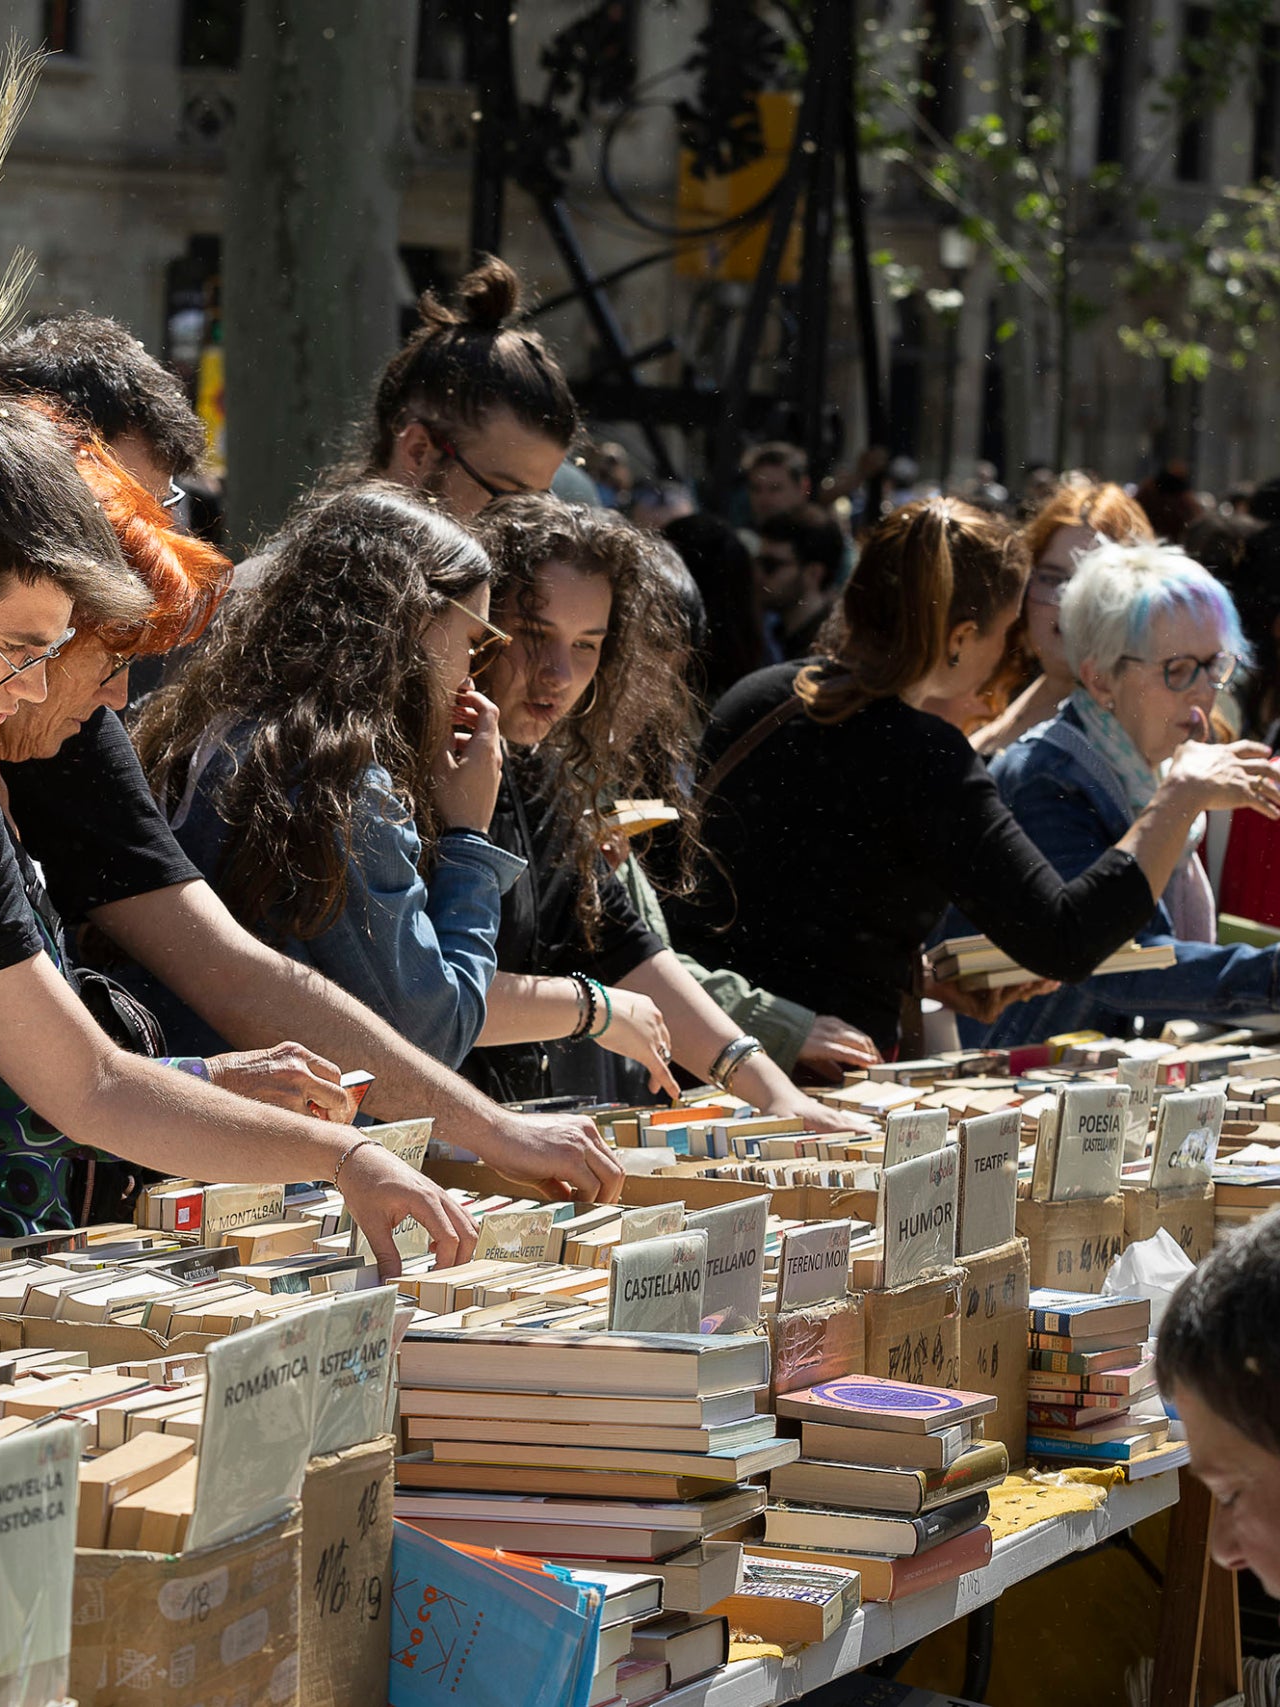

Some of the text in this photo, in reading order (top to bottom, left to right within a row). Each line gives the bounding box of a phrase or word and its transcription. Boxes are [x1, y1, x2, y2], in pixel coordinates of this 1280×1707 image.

[1078, 1115, 1120, 1133] POESIA
[219, 1201, 283, 1230] MONTALBÁN
[898, 1202, 953, 1242] HUMOR
[706, 1249, 756, 1278] TELLANO
[787, 1248, 849, 1276] TERENCI MOIX
[624, 1269, 701, 1302] CASTELLANO
[224, 1355, 309, 1408] ROMÁNTICA
